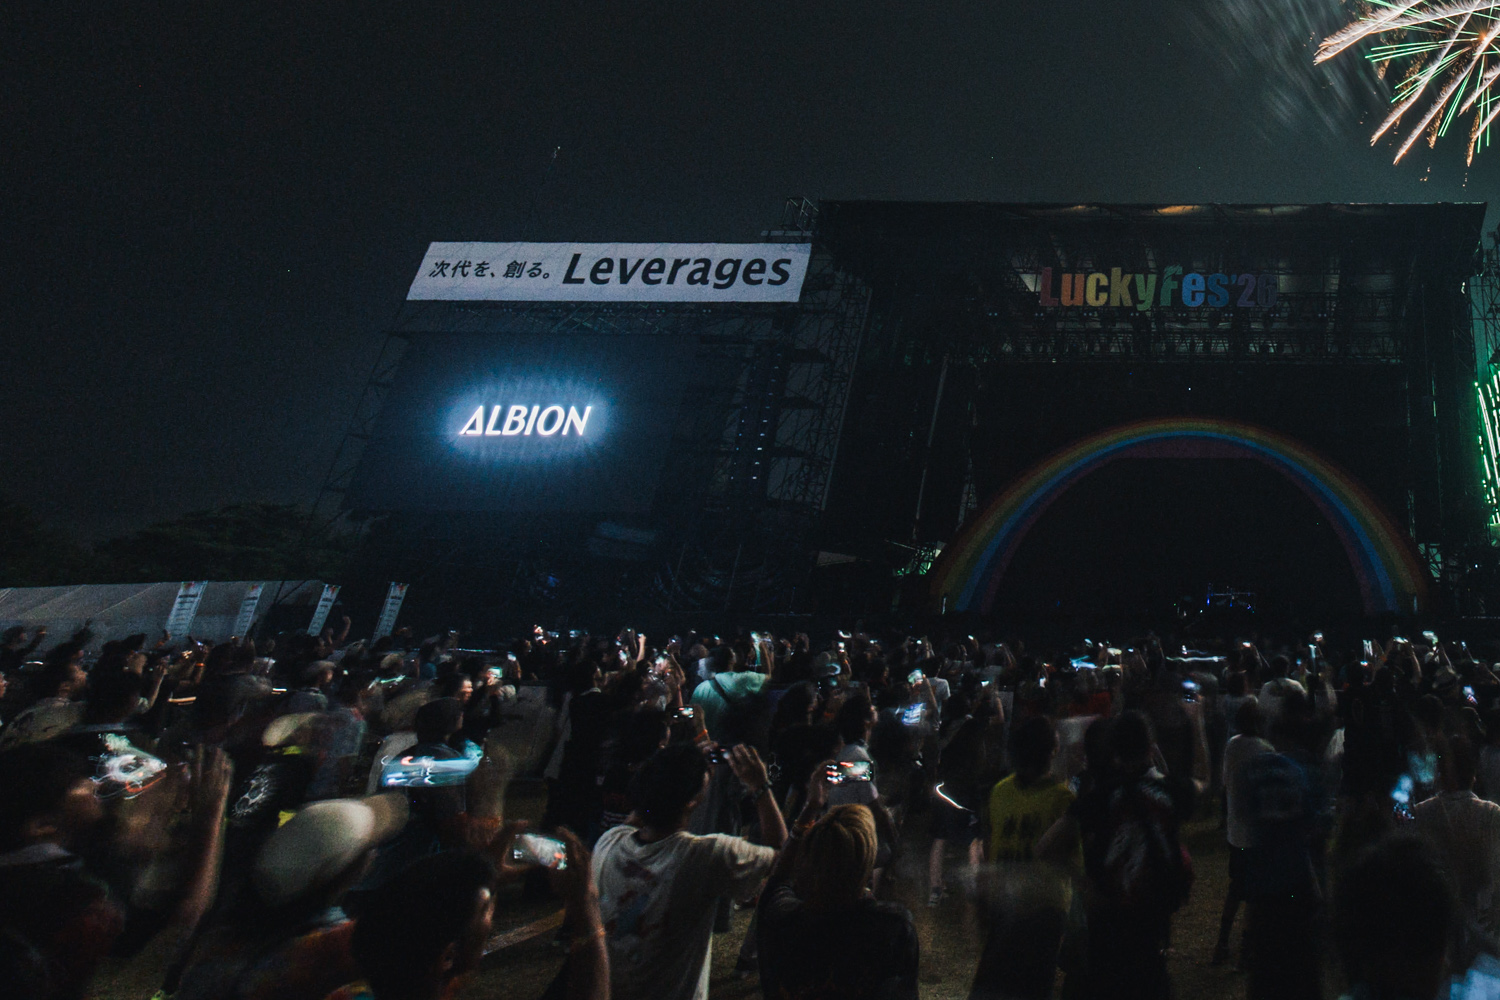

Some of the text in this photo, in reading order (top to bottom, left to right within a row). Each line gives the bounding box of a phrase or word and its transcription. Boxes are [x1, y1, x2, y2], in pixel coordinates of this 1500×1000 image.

[428, 253, 792, 289] 次代を、創る。 Leverages
[459, 404, 592, 436] ALBION
